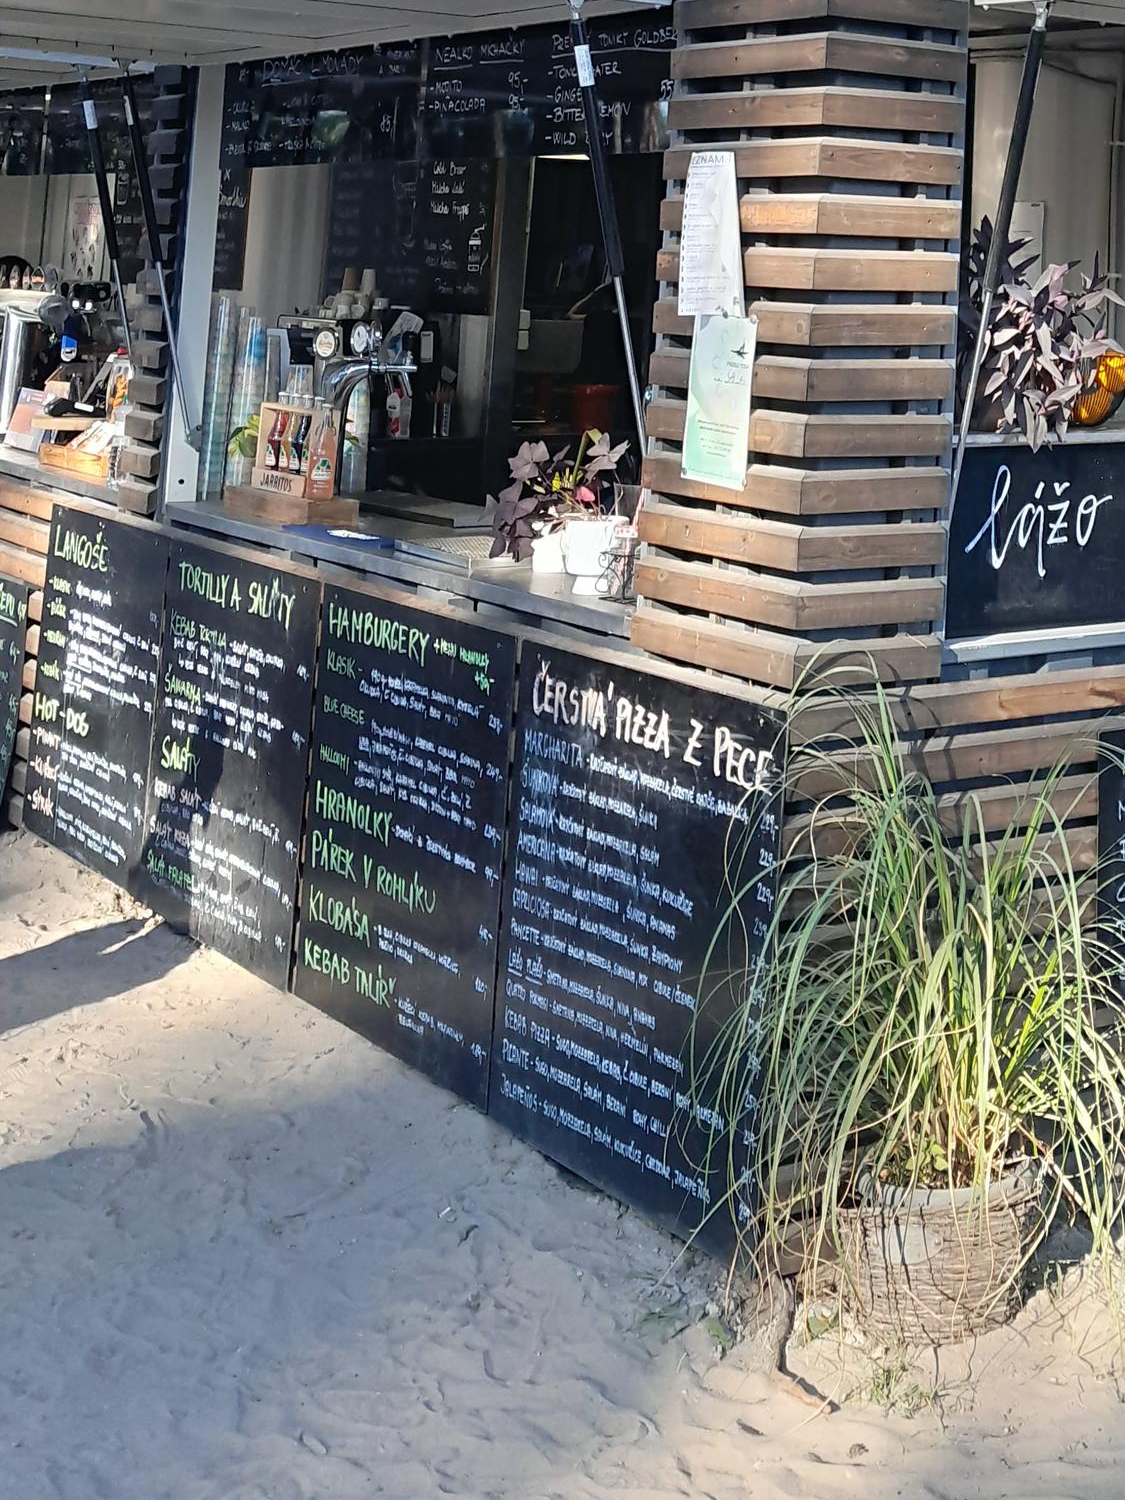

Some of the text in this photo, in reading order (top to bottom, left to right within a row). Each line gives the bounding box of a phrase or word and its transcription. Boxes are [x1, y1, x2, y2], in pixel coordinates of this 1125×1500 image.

[593, 61, 622, 76] ATER
[599, 102, 631, 119] EMON
[261, 473, 292, 493] JARRITOS
[965, 465, 1114, 579] lážo
[179, 562, 230, 608] TORTILLY
[230, 578, 242, 611] A
[170, 608, 196, 638] KEBAB
[329, 602, 430, 667] HAMBURGERY
[615, 695, 670, 759] PIZZA
[683, 717, 704, 767] Z
[315, 779, 393, 848] HRANOLKY
[311, 827, 357, 882] PÁREK
[363, 854, 373, 889] V
[376, 866, 436, 914] ROHLÍKU
[309, 884, 371, 948] KLOBÁSA
[304, 937, 350, 984] KEBAB
